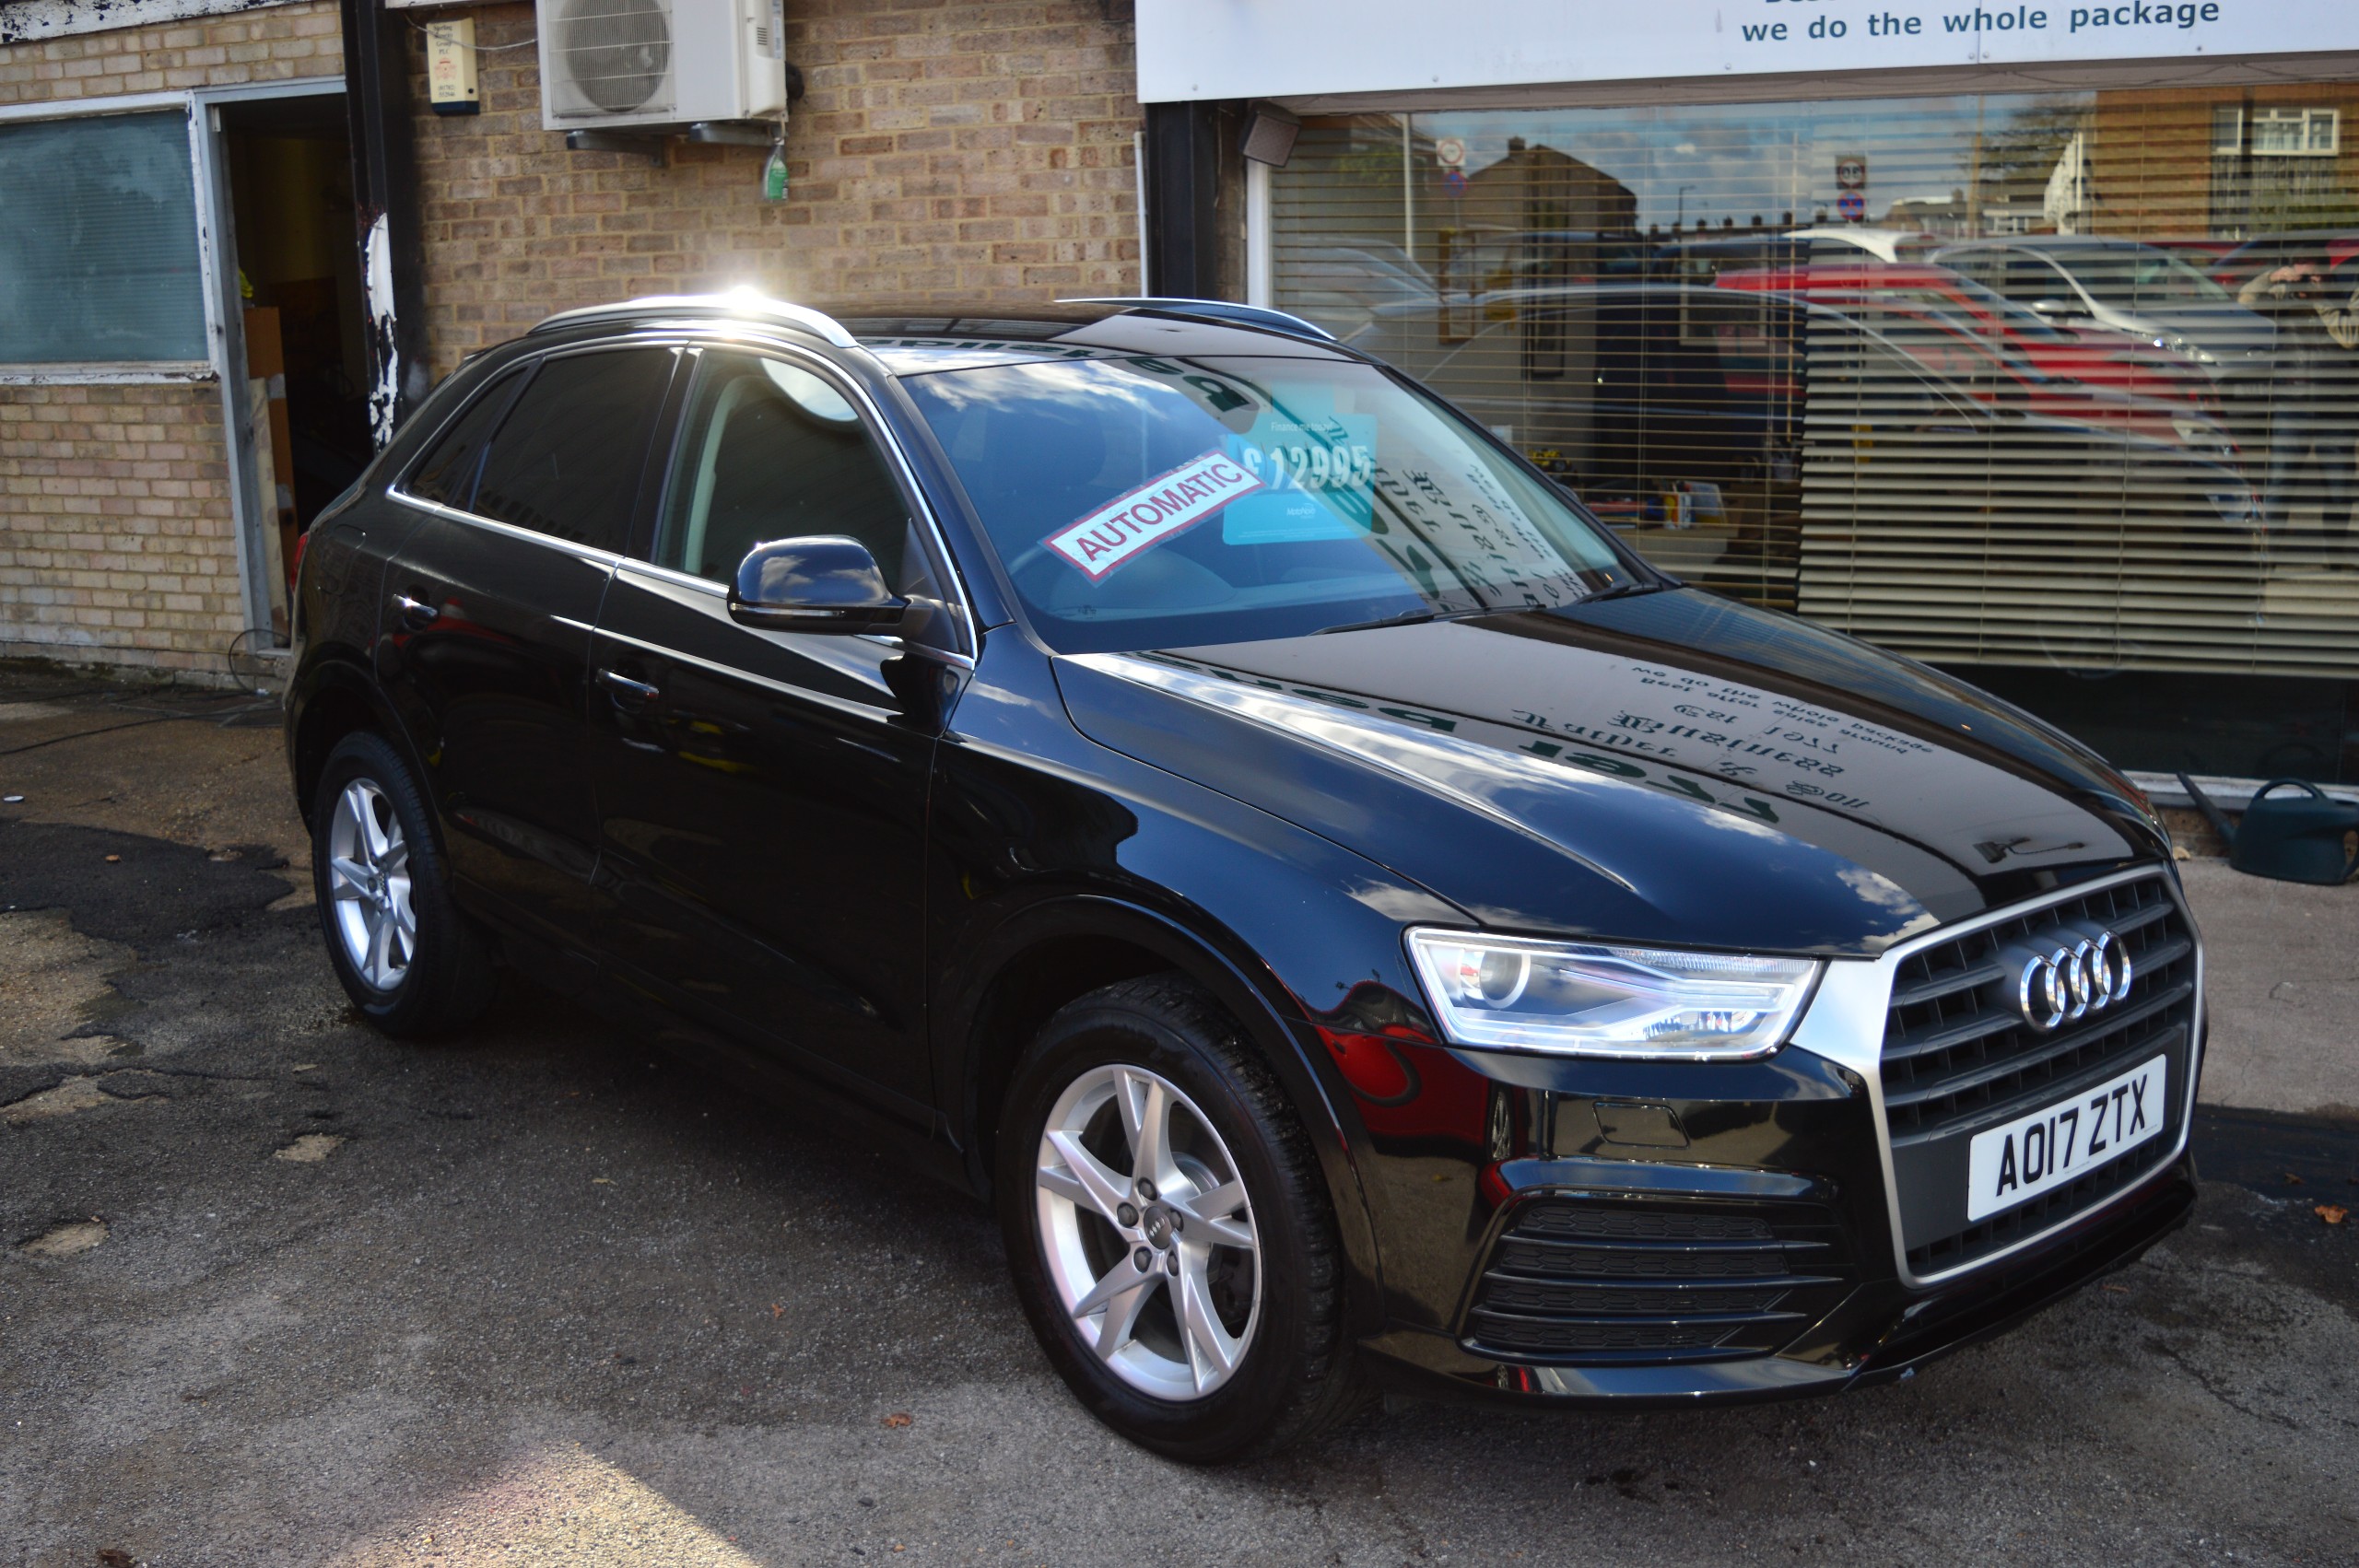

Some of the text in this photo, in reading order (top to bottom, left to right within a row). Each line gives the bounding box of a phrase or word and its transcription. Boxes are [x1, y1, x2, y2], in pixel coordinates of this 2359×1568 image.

[1742, 0, 2220, 41] we do the whole package
[1271, 422, 1298, 432] Finance
[1075, 463, 1243, 562] AUTOMATIC
[1996, 1073, 2148, 1197] AO17 ZTX
